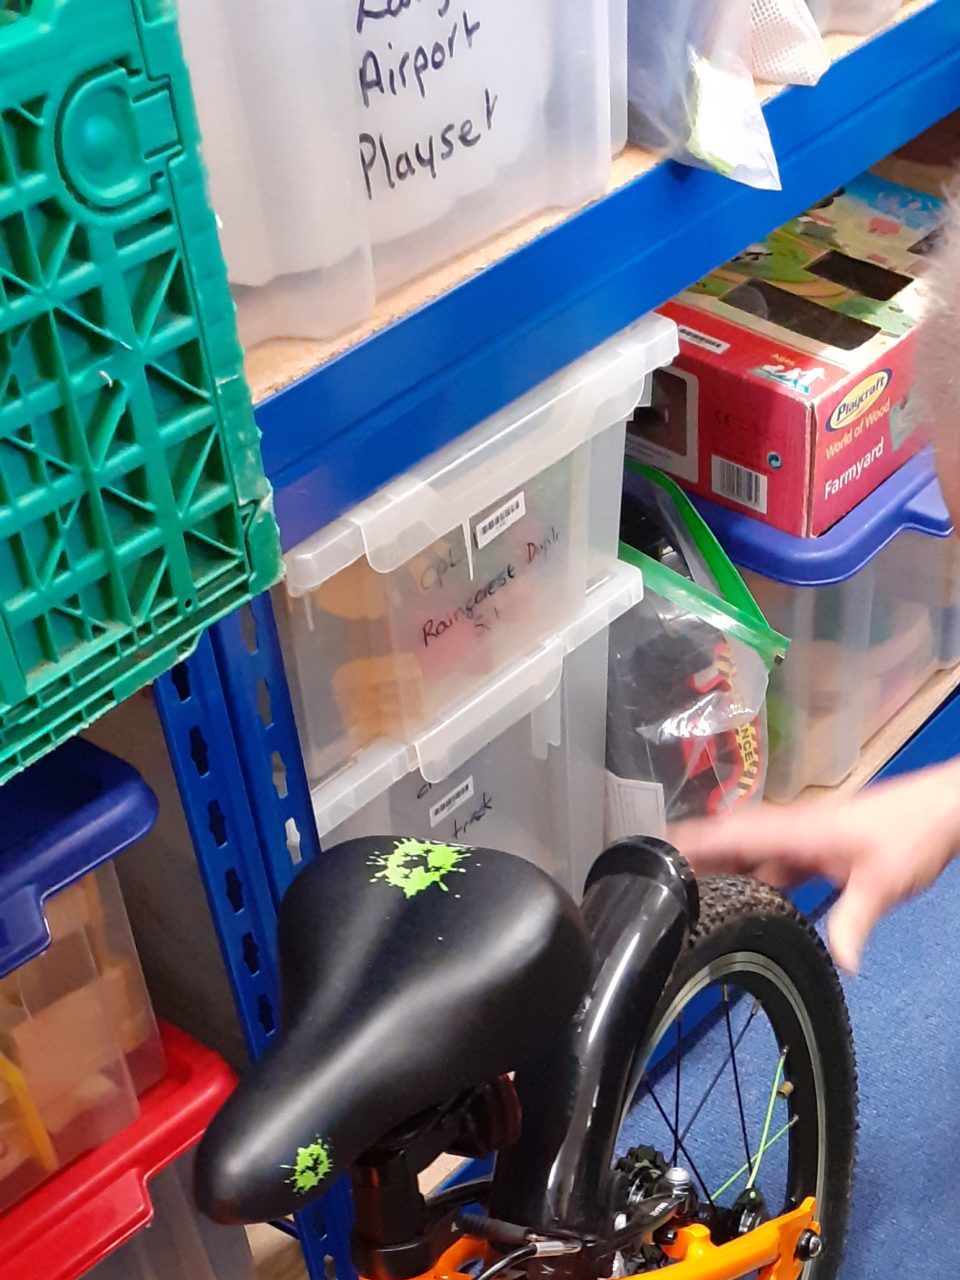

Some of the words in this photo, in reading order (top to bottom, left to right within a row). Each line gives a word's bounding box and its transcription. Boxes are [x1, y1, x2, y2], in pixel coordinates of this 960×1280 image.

[359, 11, 480, 108] Airport
[359, 88, 498, 200] Playset
[825, 429, 853, 459] World
[852, 420, 863, 440] of
[864, 397, 891, 430] Wood
[836, 376, 885, 422] Playcraft
[824, 437, 884, 501] Farmyard
